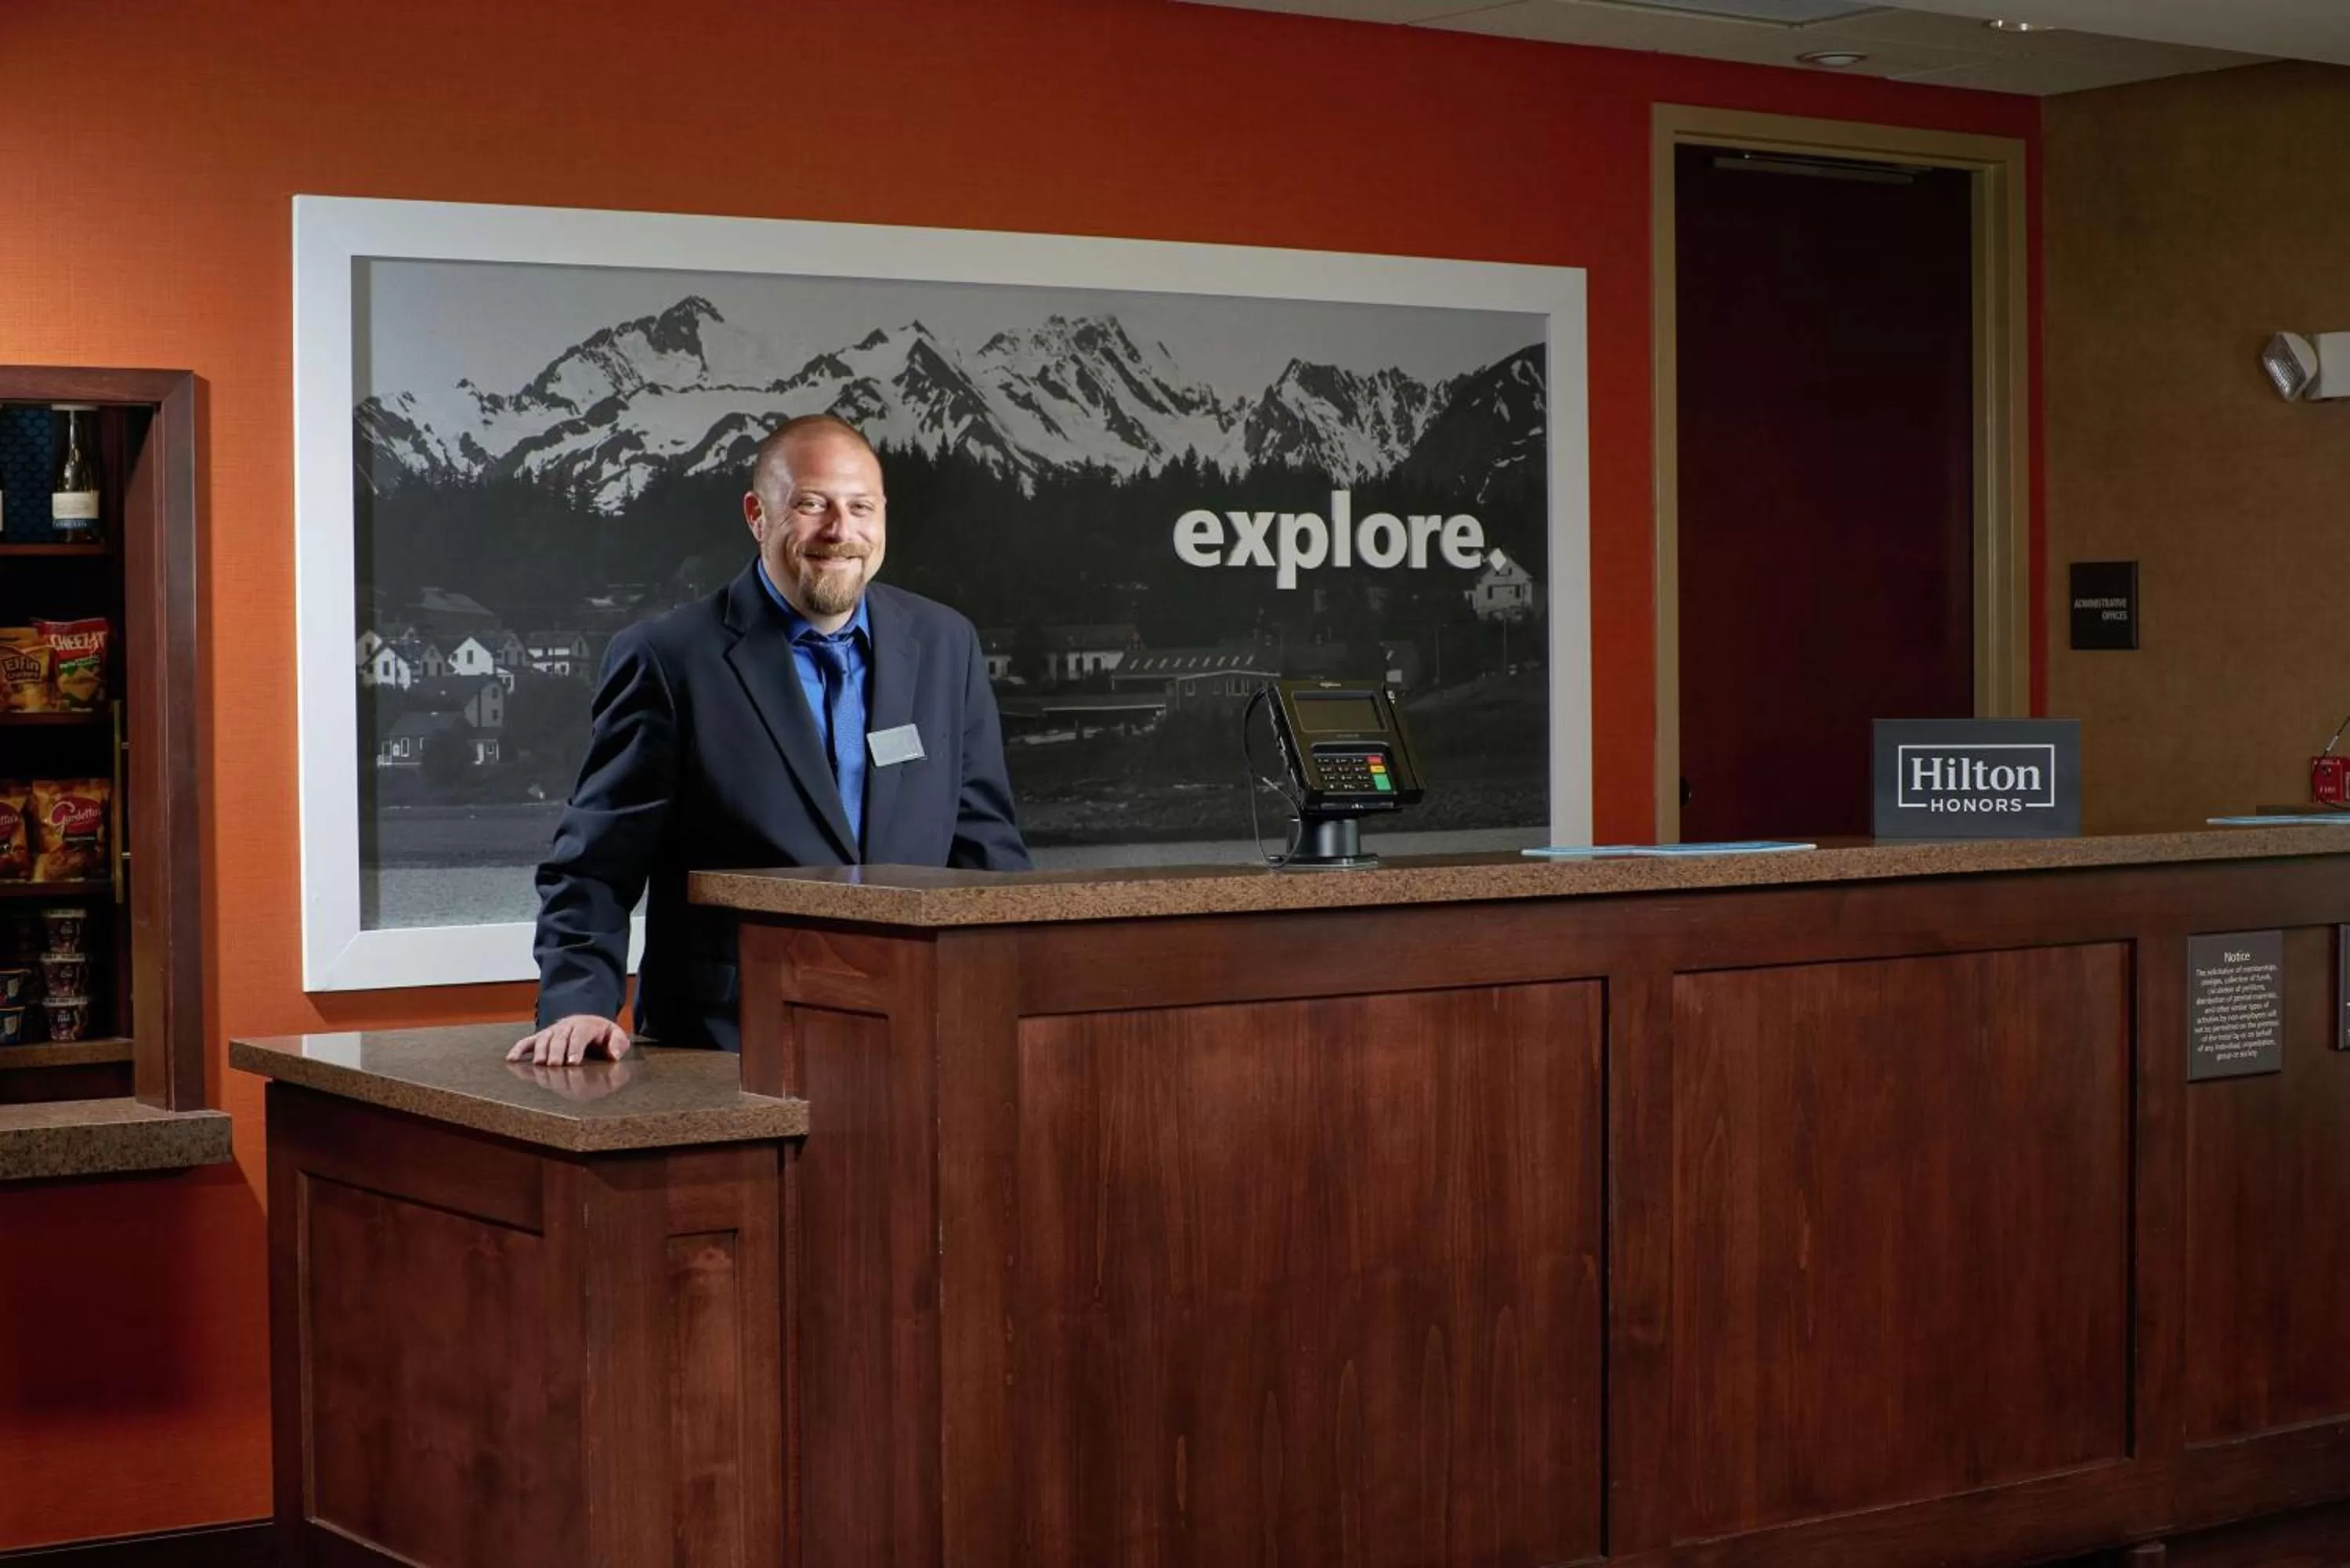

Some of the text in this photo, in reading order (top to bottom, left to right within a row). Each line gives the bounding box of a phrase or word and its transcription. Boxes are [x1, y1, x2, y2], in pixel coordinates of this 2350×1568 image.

[1173, 490, 1507, 589] explore.
[1911, 757, 2041, 791] Hilton
[1930, 798, 2022, 812] HONORS
[2224, 951, 2251, 962] Notice
